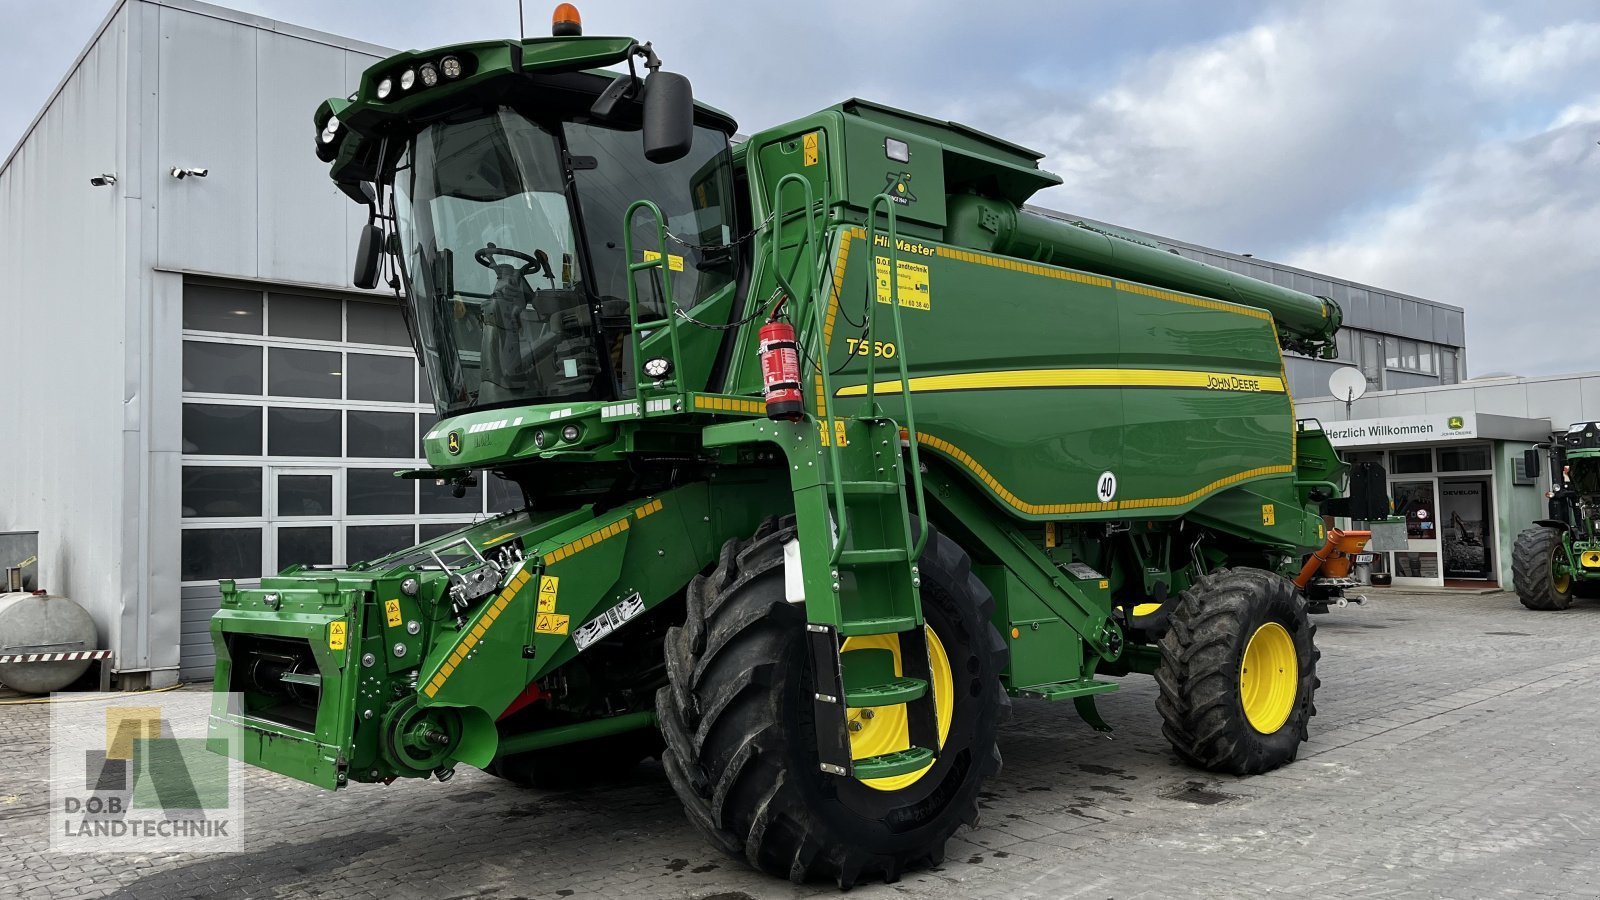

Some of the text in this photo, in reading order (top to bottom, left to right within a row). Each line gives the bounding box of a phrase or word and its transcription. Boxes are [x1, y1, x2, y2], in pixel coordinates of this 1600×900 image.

[897, 262, 927, 273] andtechnik
[1207, 374, 1260, 390] JOHN DEERE
[1326, 424, 1434, 439] Herzlich Willkommen
[1101, 477, 1113, 498] 40
